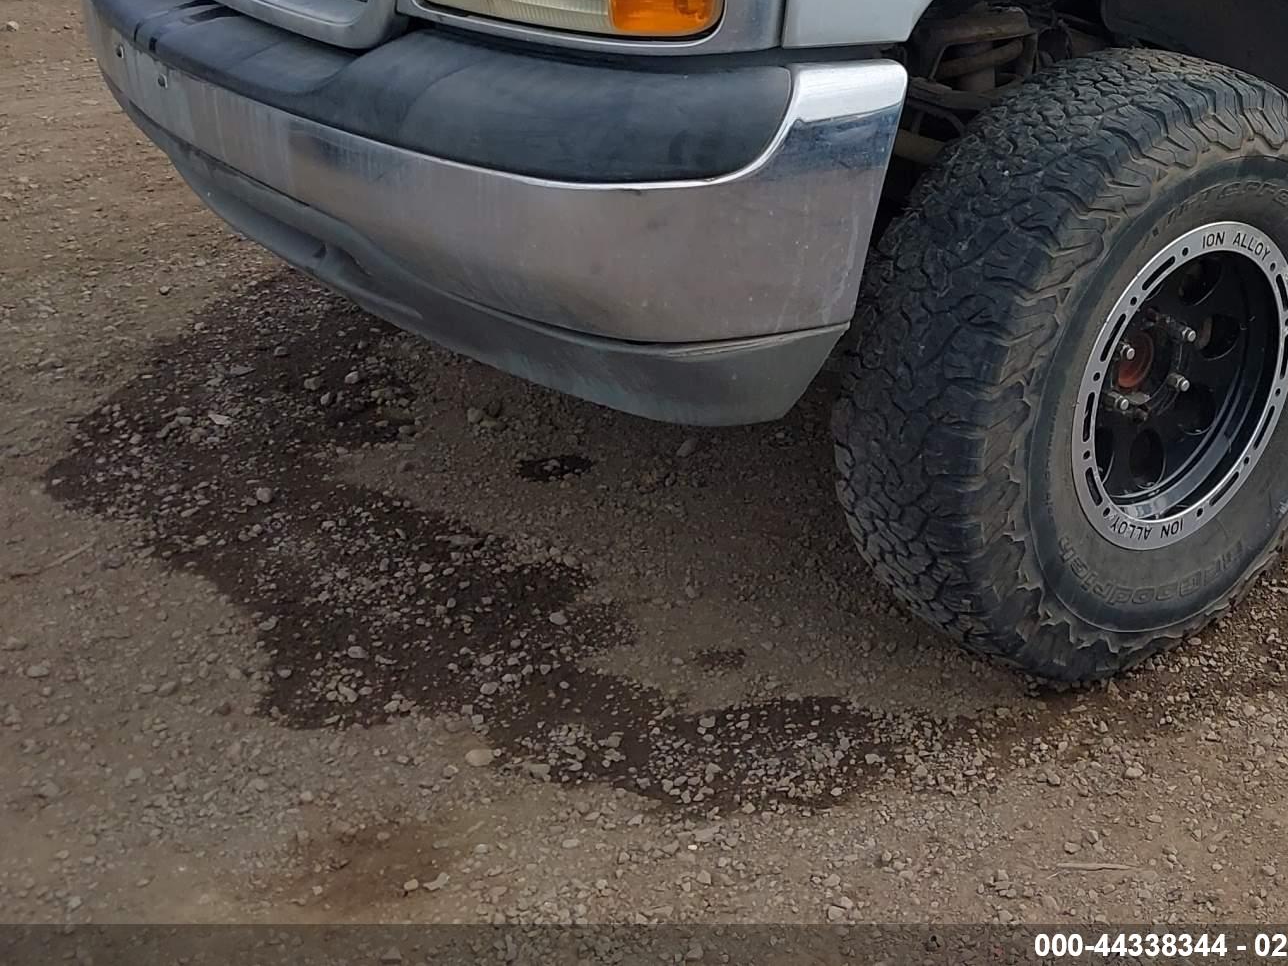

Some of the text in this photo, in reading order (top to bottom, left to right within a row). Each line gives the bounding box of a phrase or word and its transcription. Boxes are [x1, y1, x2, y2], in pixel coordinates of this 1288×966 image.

[1202, 231, 1272, 262] ION ALLOY
[1110, 516, 1183, 540] ION ALLOY
